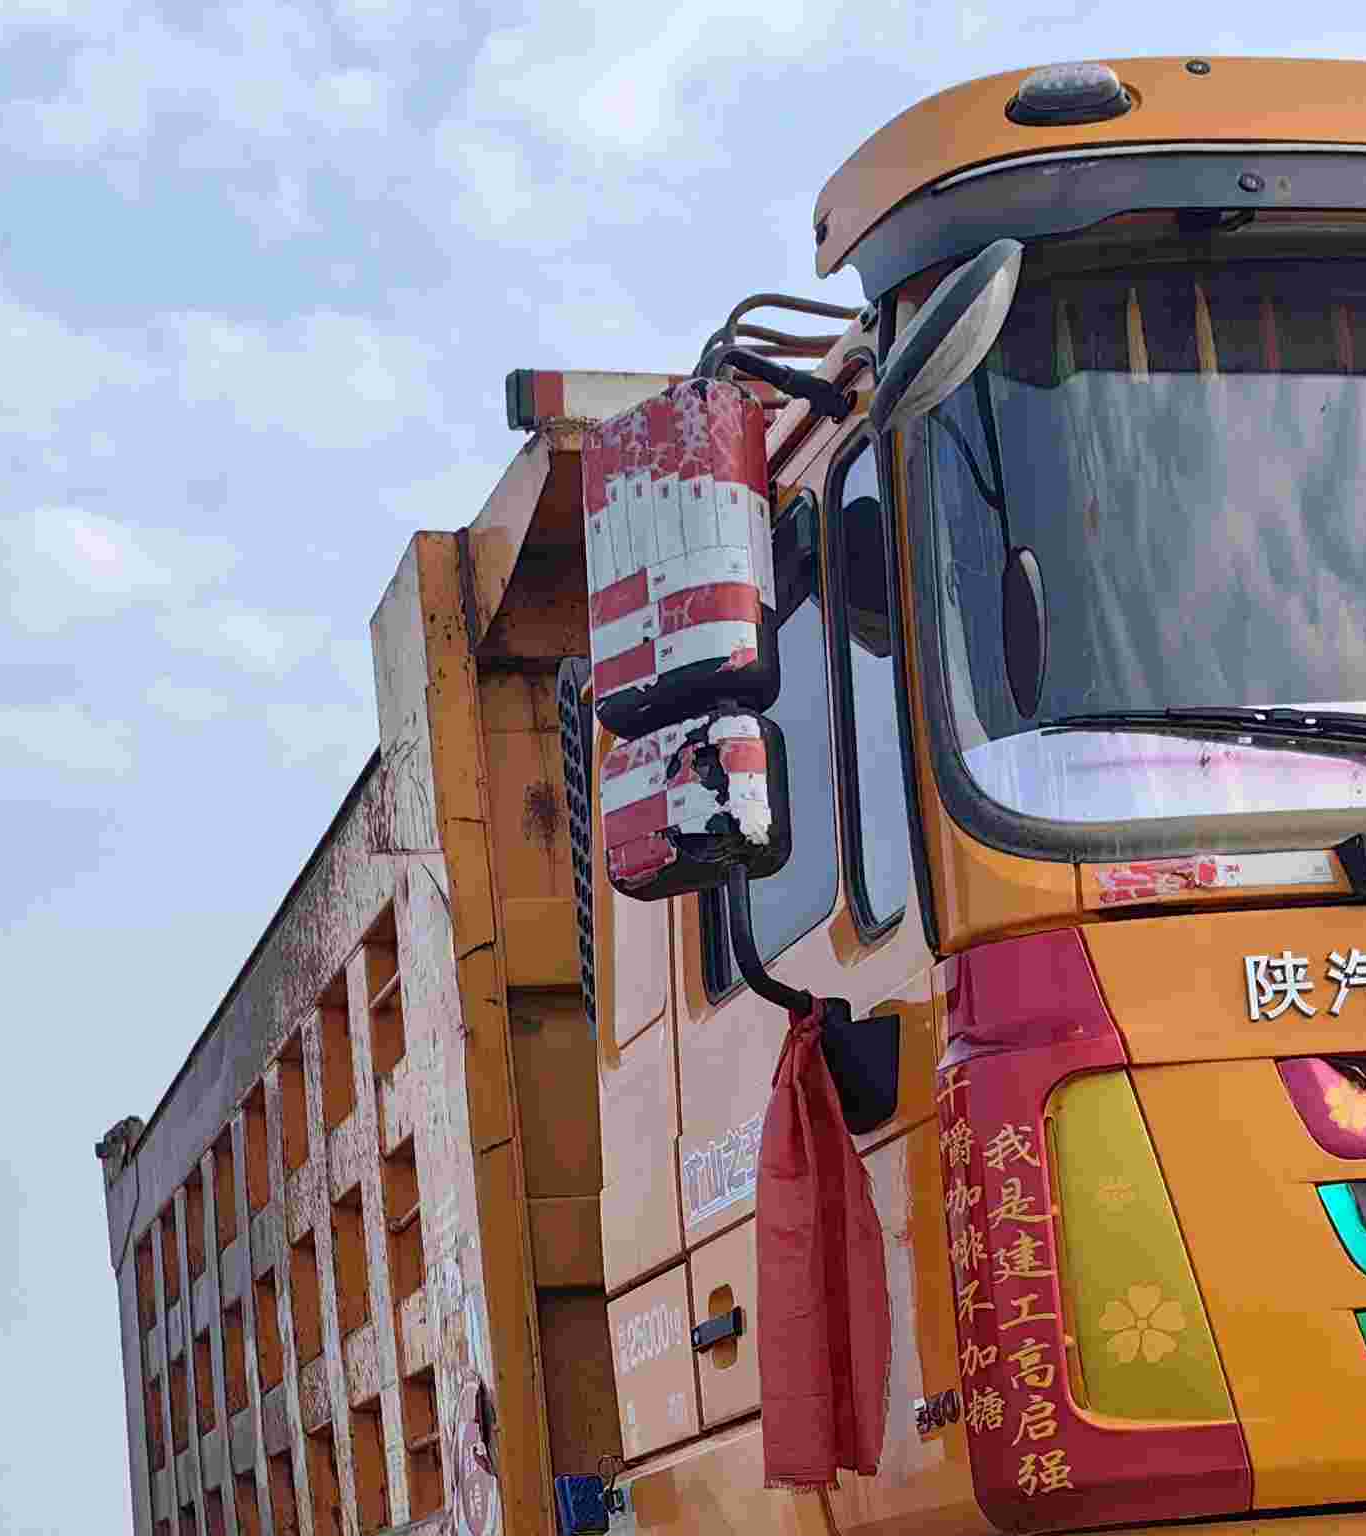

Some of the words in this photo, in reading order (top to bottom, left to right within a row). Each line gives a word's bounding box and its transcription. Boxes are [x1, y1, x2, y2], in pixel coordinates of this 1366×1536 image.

[982, 1122, 1075, 1498] 我是建工高启强
